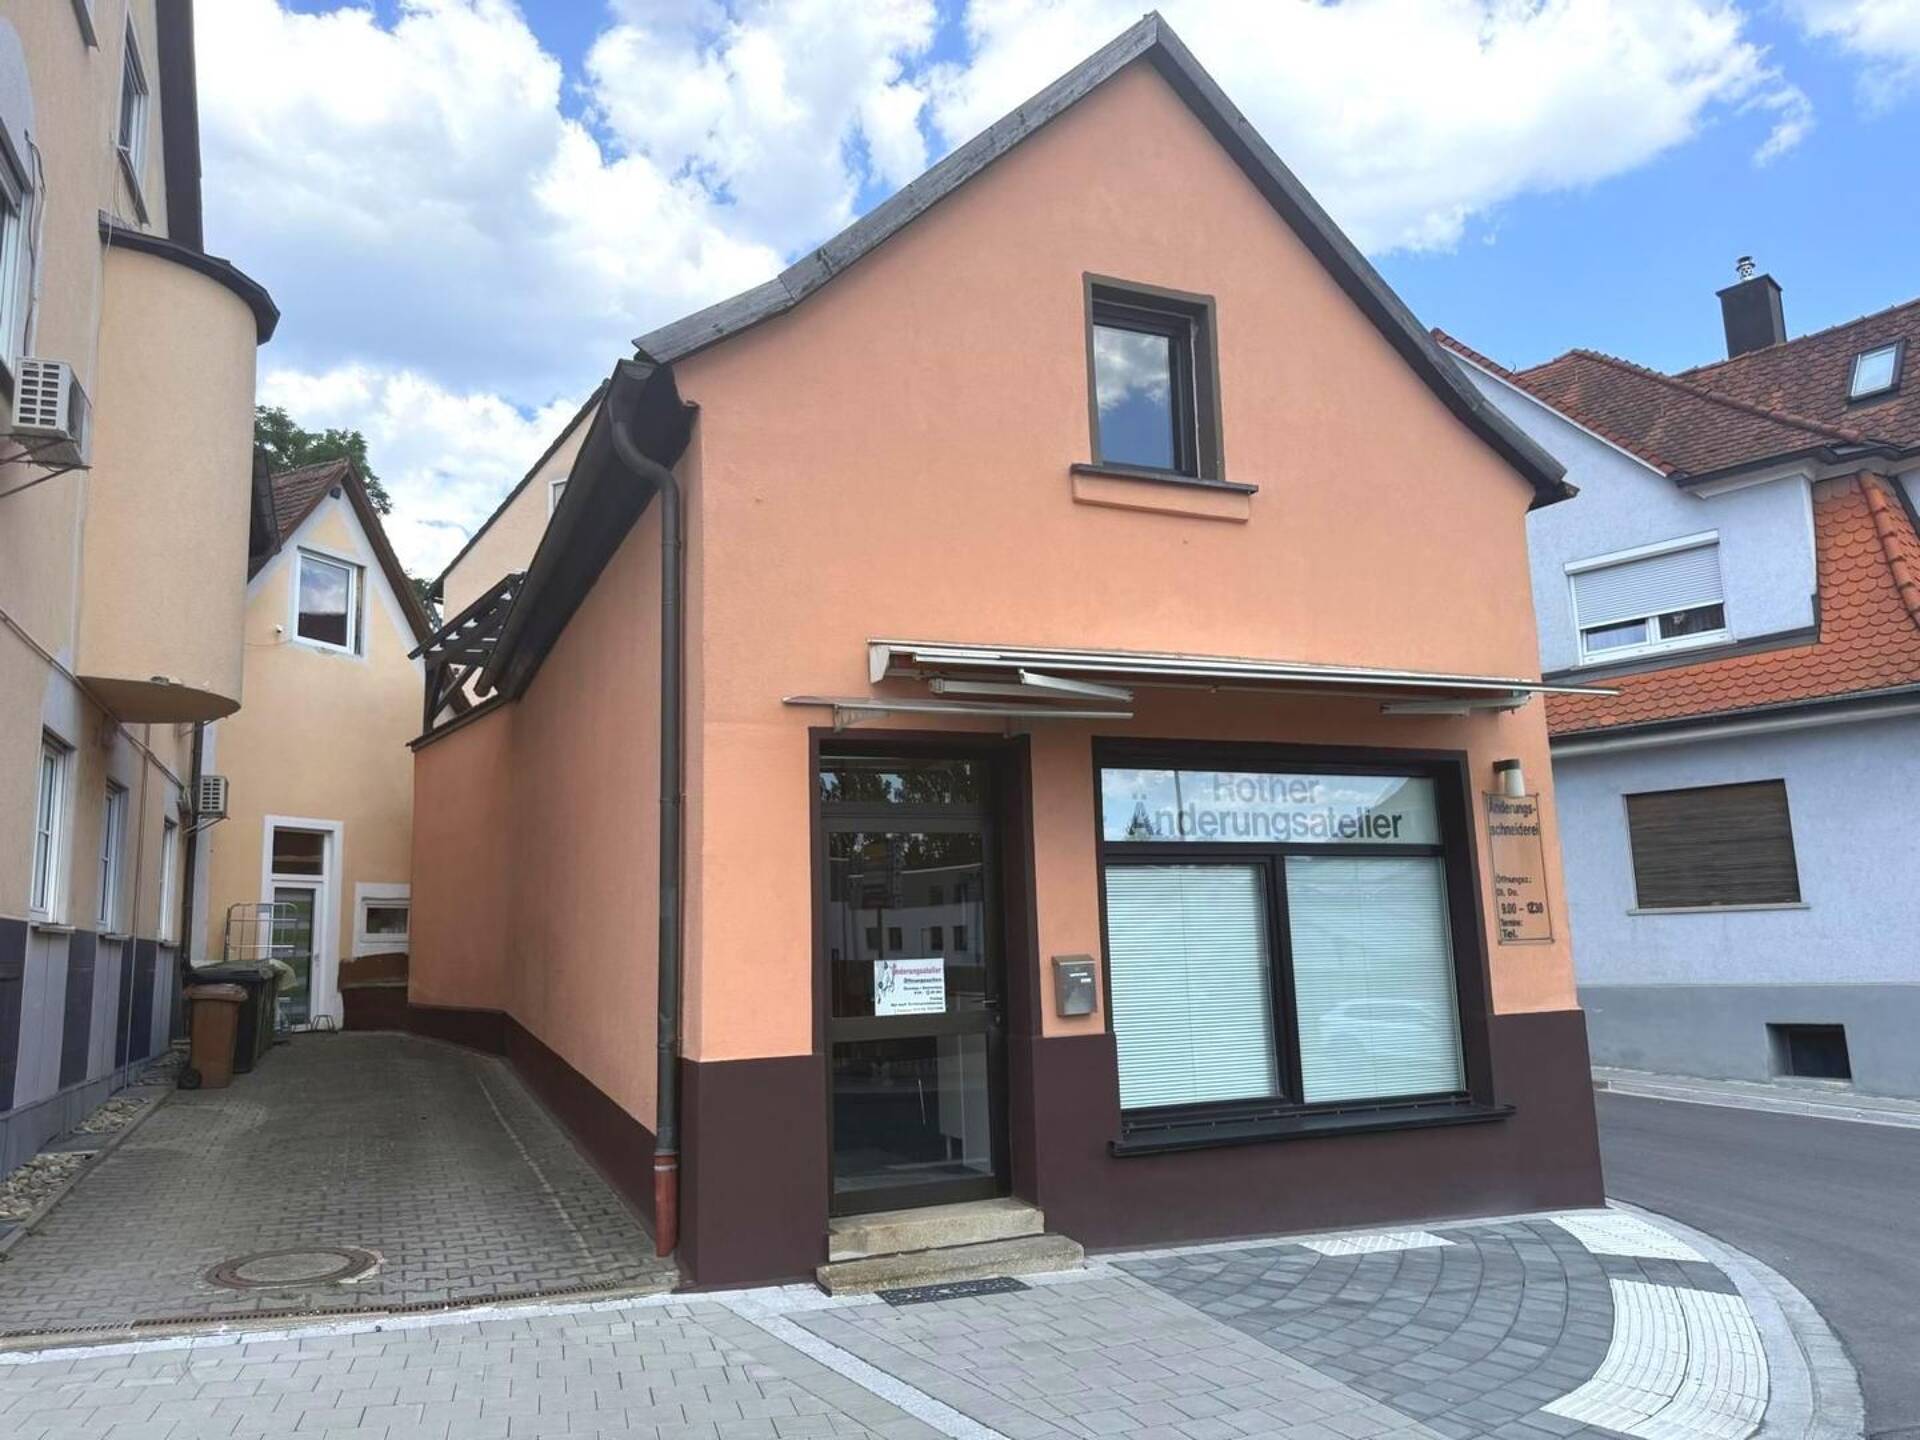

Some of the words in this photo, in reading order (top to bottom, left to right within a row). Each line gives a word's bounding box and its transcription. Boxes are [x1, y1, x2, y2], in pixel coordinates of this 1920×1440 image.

[1213, 774, 1320, 804] Rother
[1127, 793, 1404, 841] Änderungsatelier
[1489, 822, 1540, 836] schneiderei
